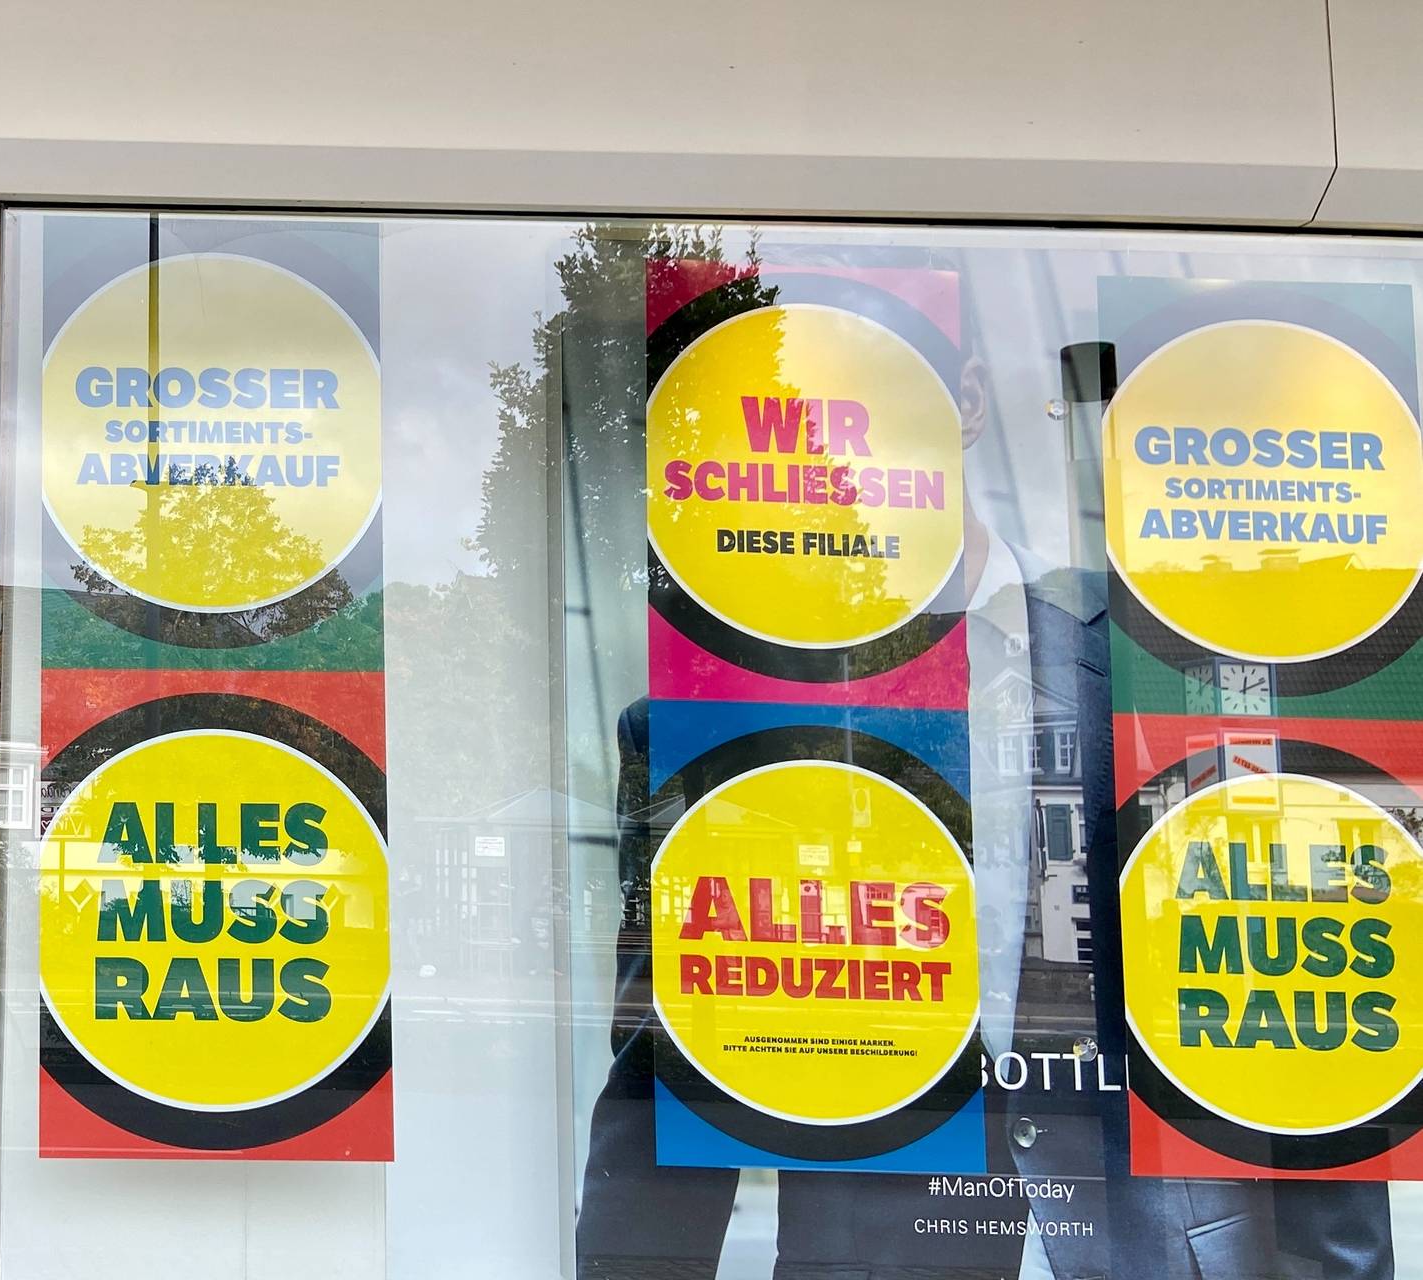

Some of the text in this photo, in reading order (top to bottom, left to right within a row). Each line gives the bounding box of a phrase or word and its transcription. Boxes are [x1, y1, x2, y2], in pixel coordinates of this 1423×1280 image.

[76, 366, 340, 409] GROSSER
[105, 420, 313, 444] SORTIMENTS-
[741, 396, 872, 456] WIR
[1134, 426, 1385, 471] GROSSER
[76, 453, 340, 487] ABVERKAUF
[663, 460, 945, 511] SCHLIESSEN
[1165, 477, 1361, 503] SORTIMENTS-
[717, 529, 901, 559] DIESE FILIALE
[1139, 509, 1387, 545] ABVERKAUF
[97, 802, 329, 866] ALLES
[1175, 841, 1392, 905] ALLES
[97, 879, 329, 944] MUSS
[679, 876, 950, 948] ALLES
[1178, 915, 1395, 979] MUSS
[95, 957, 332, 1023] RAUS
[680, 954, 952, 1002] REDUZIERT
[744, 1036, 896, 1047] AUSGENOMMEN SIND EINIGE MARKEN.
[1177, 988, 1400, 1052] RAUS
[723, 1044, 918, 1057] BITTE ACHTEN SIE AUF UNSERE BESCHILDERUNG!
[928, 1176, 1075, 1203] #ManOfToday
[914, 1218, 1094, 1237] CHRIS HEMSWORTH
